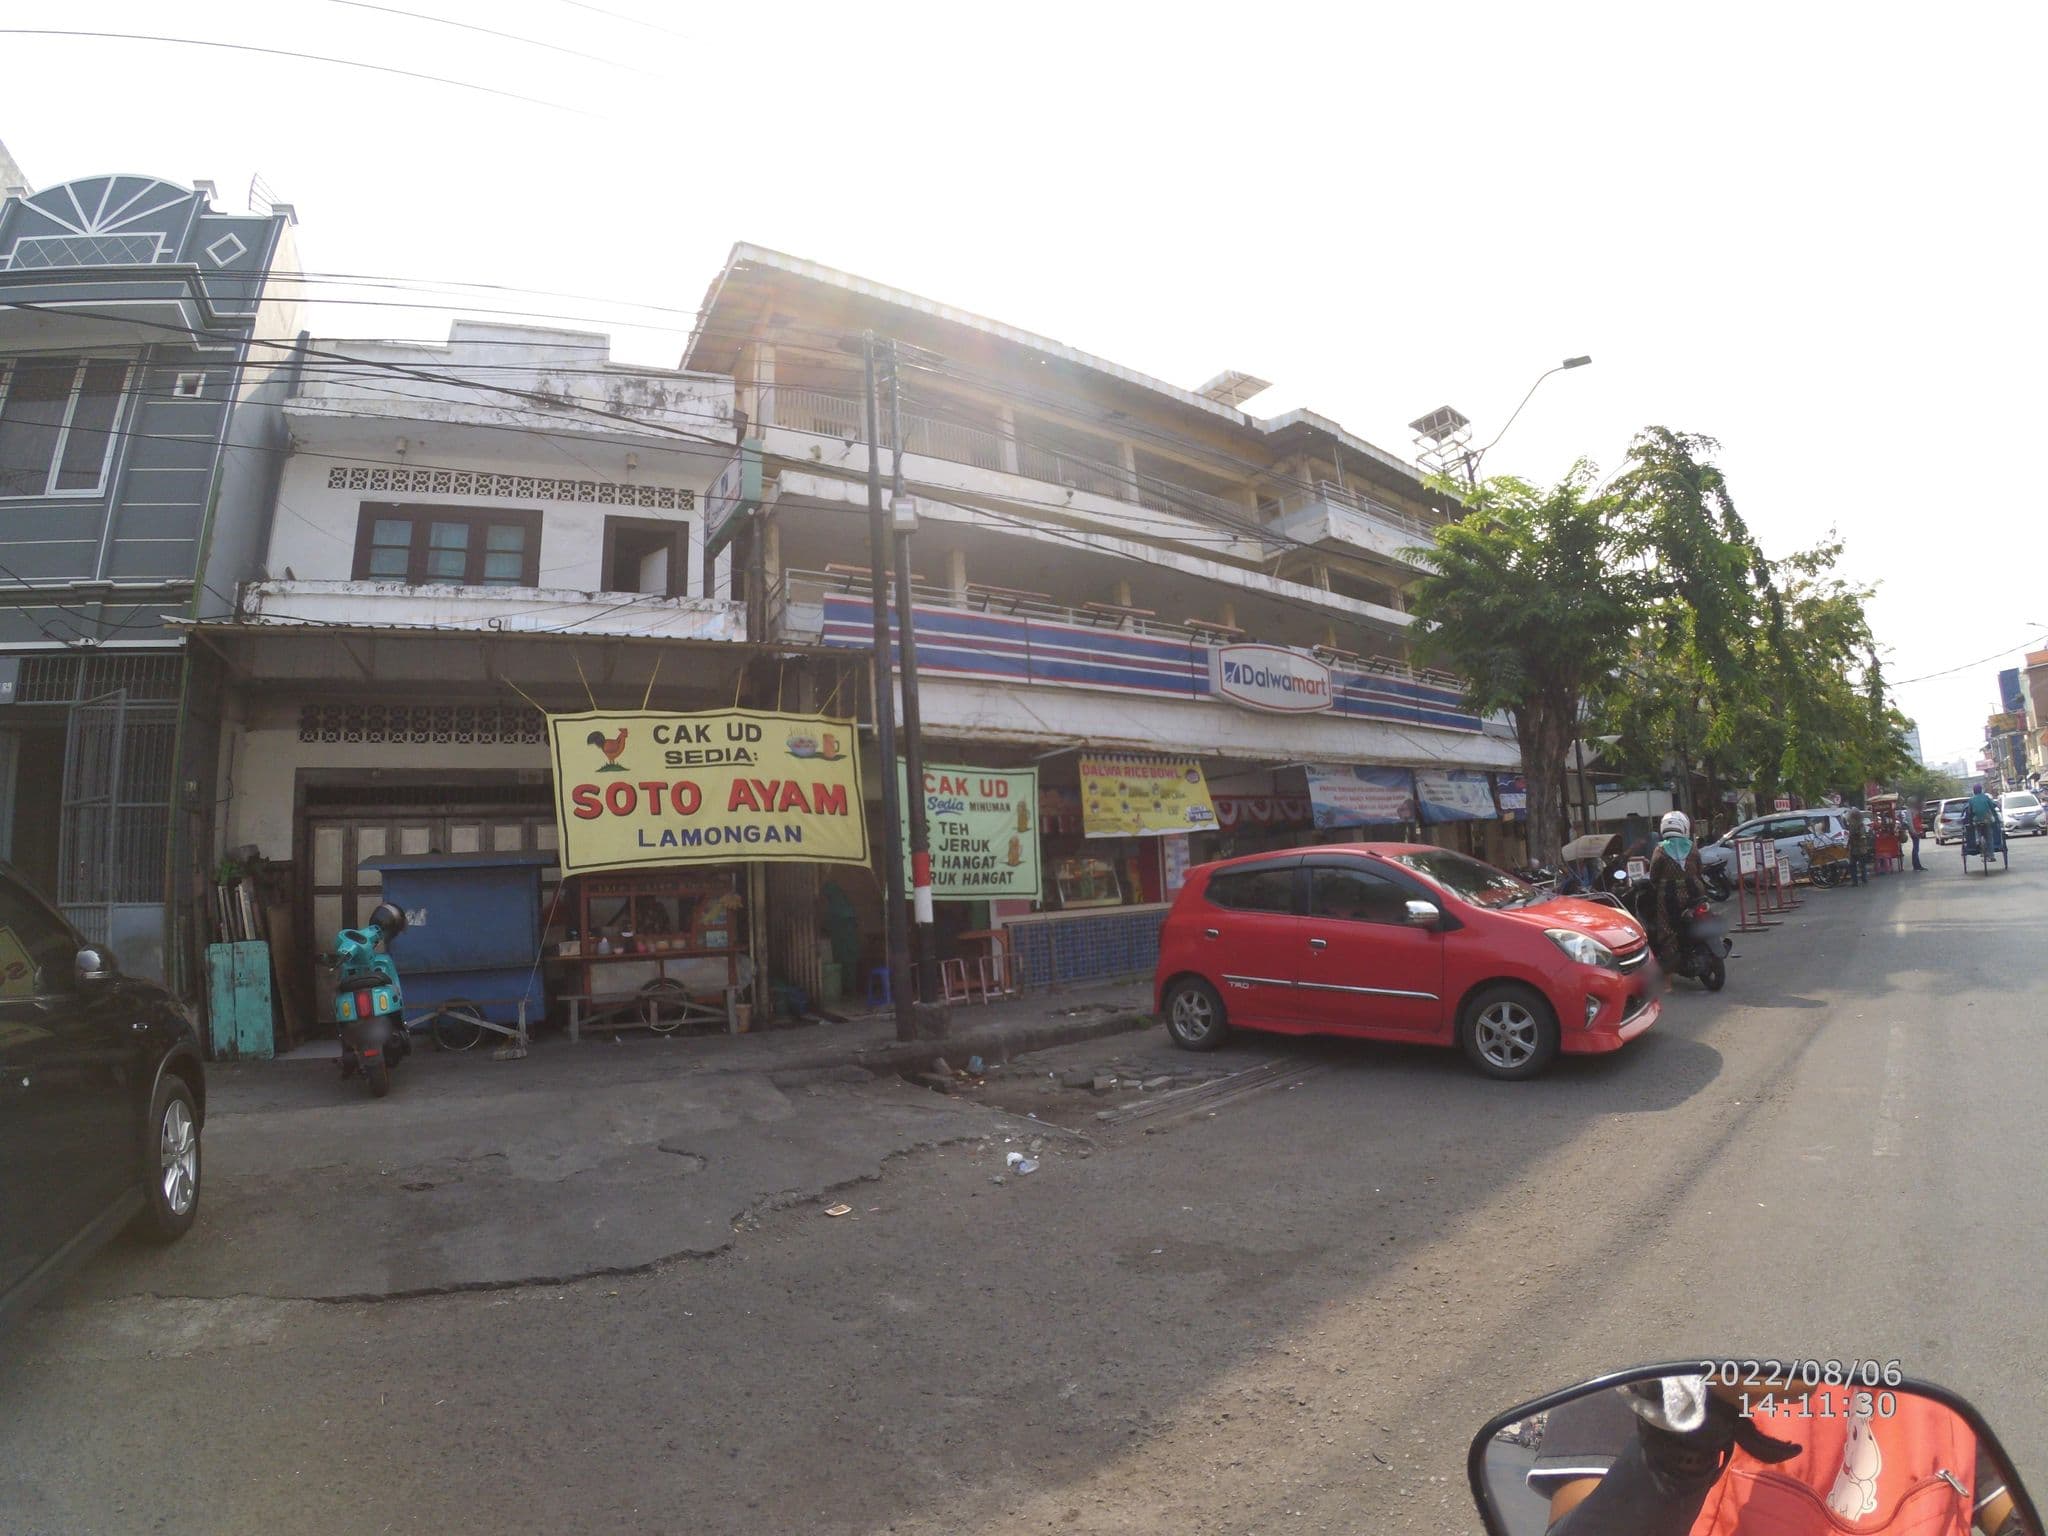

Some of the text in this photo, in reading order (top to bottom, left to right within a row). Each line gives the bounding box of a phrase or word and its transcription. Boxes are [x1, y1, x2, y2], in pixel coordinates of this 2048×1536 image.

[1242, 665, 1327, 697] Dalwamart
[653, 722, 762, 744] CAK UD
[665, 747, 758, 766] SEDIA:
[1082, 765, 1181, 779] DALWA RICE BOWL
[924, 774, 1009, 798] CAK UD
[571, 778, 848, 820] SOTO AYAM
[927, 796, 1011, 812] Sedia MINUMAN
[638, 824, 802, 848] LAMONGAN
[938, 821, 969, 836] TEH
[938, 838, 991, 853] JERUK
[942, 855, 997, 870] HANGAT
[962, 871, 1014, 886] HANGAT
